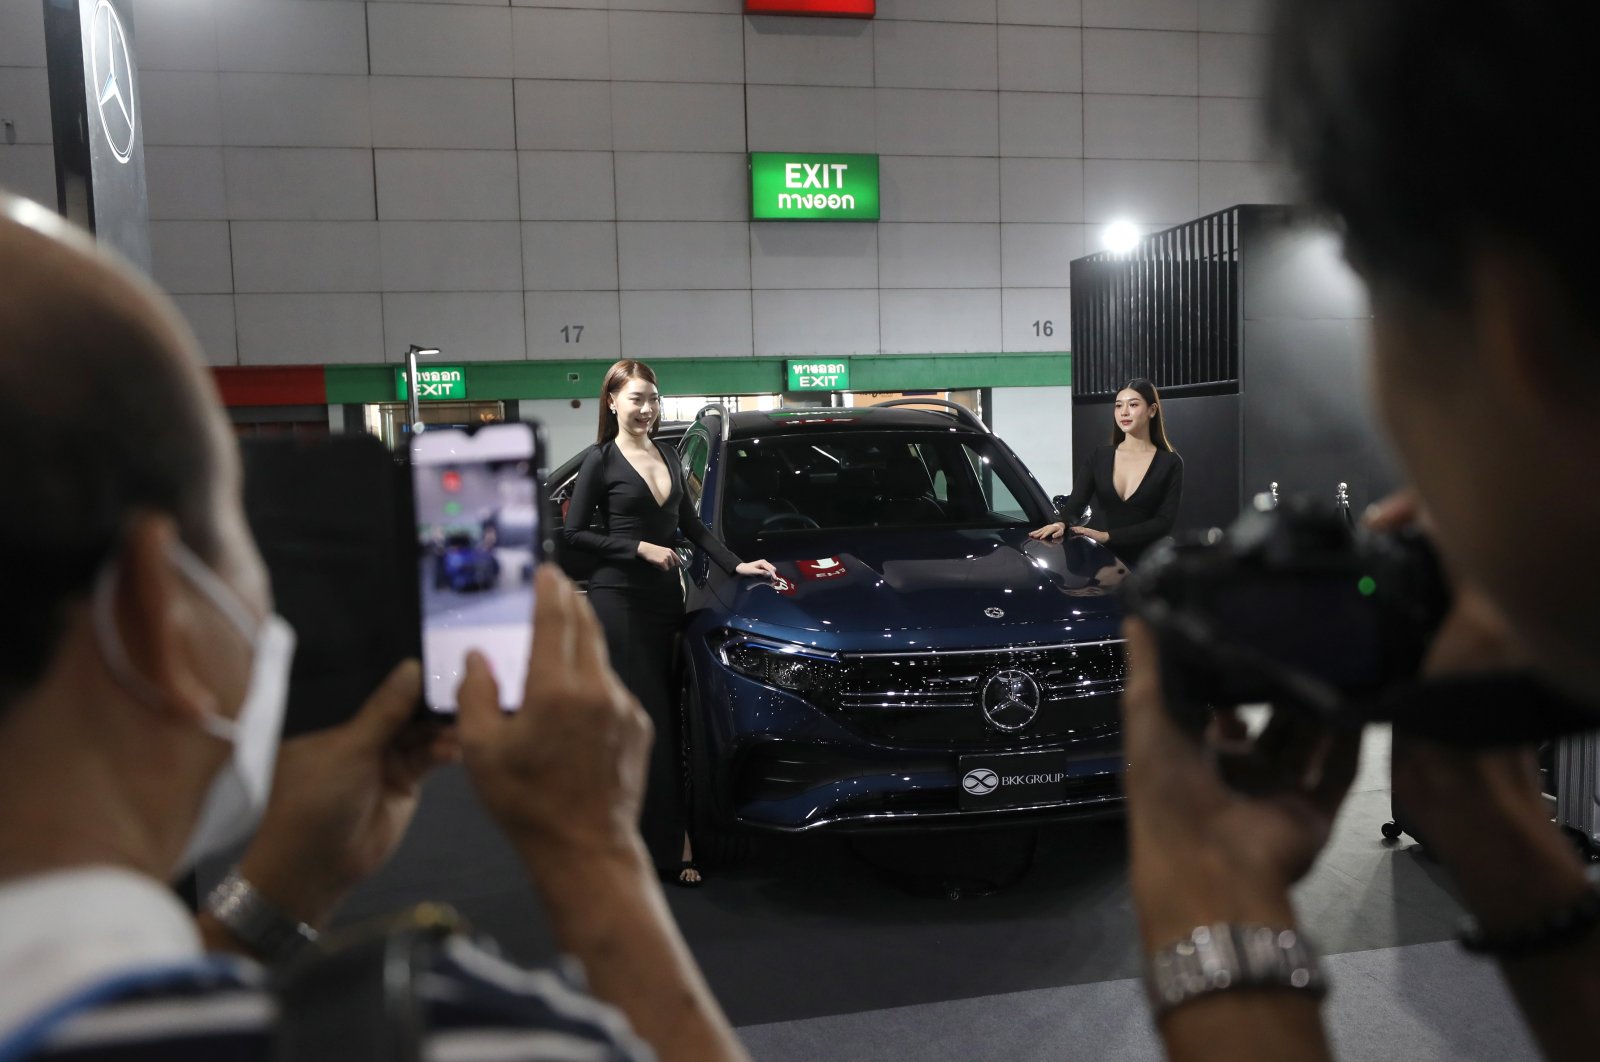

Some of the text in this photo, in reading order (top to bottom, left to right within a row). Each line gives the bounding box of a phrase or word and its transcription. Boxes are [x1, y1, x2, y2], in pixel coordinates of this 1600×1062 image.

[785, 163, 848, 189] EXIT
[778, 193, 855, 209] ทางออก
[560, 325, 585, 343] 17
[1032, 320, 1054, 337] 16
[793, 363, 845, 374] ทางออก
[799, 375, 839, 388] EXIT
[1001, 772, 1065, 787] BKK GROUP
